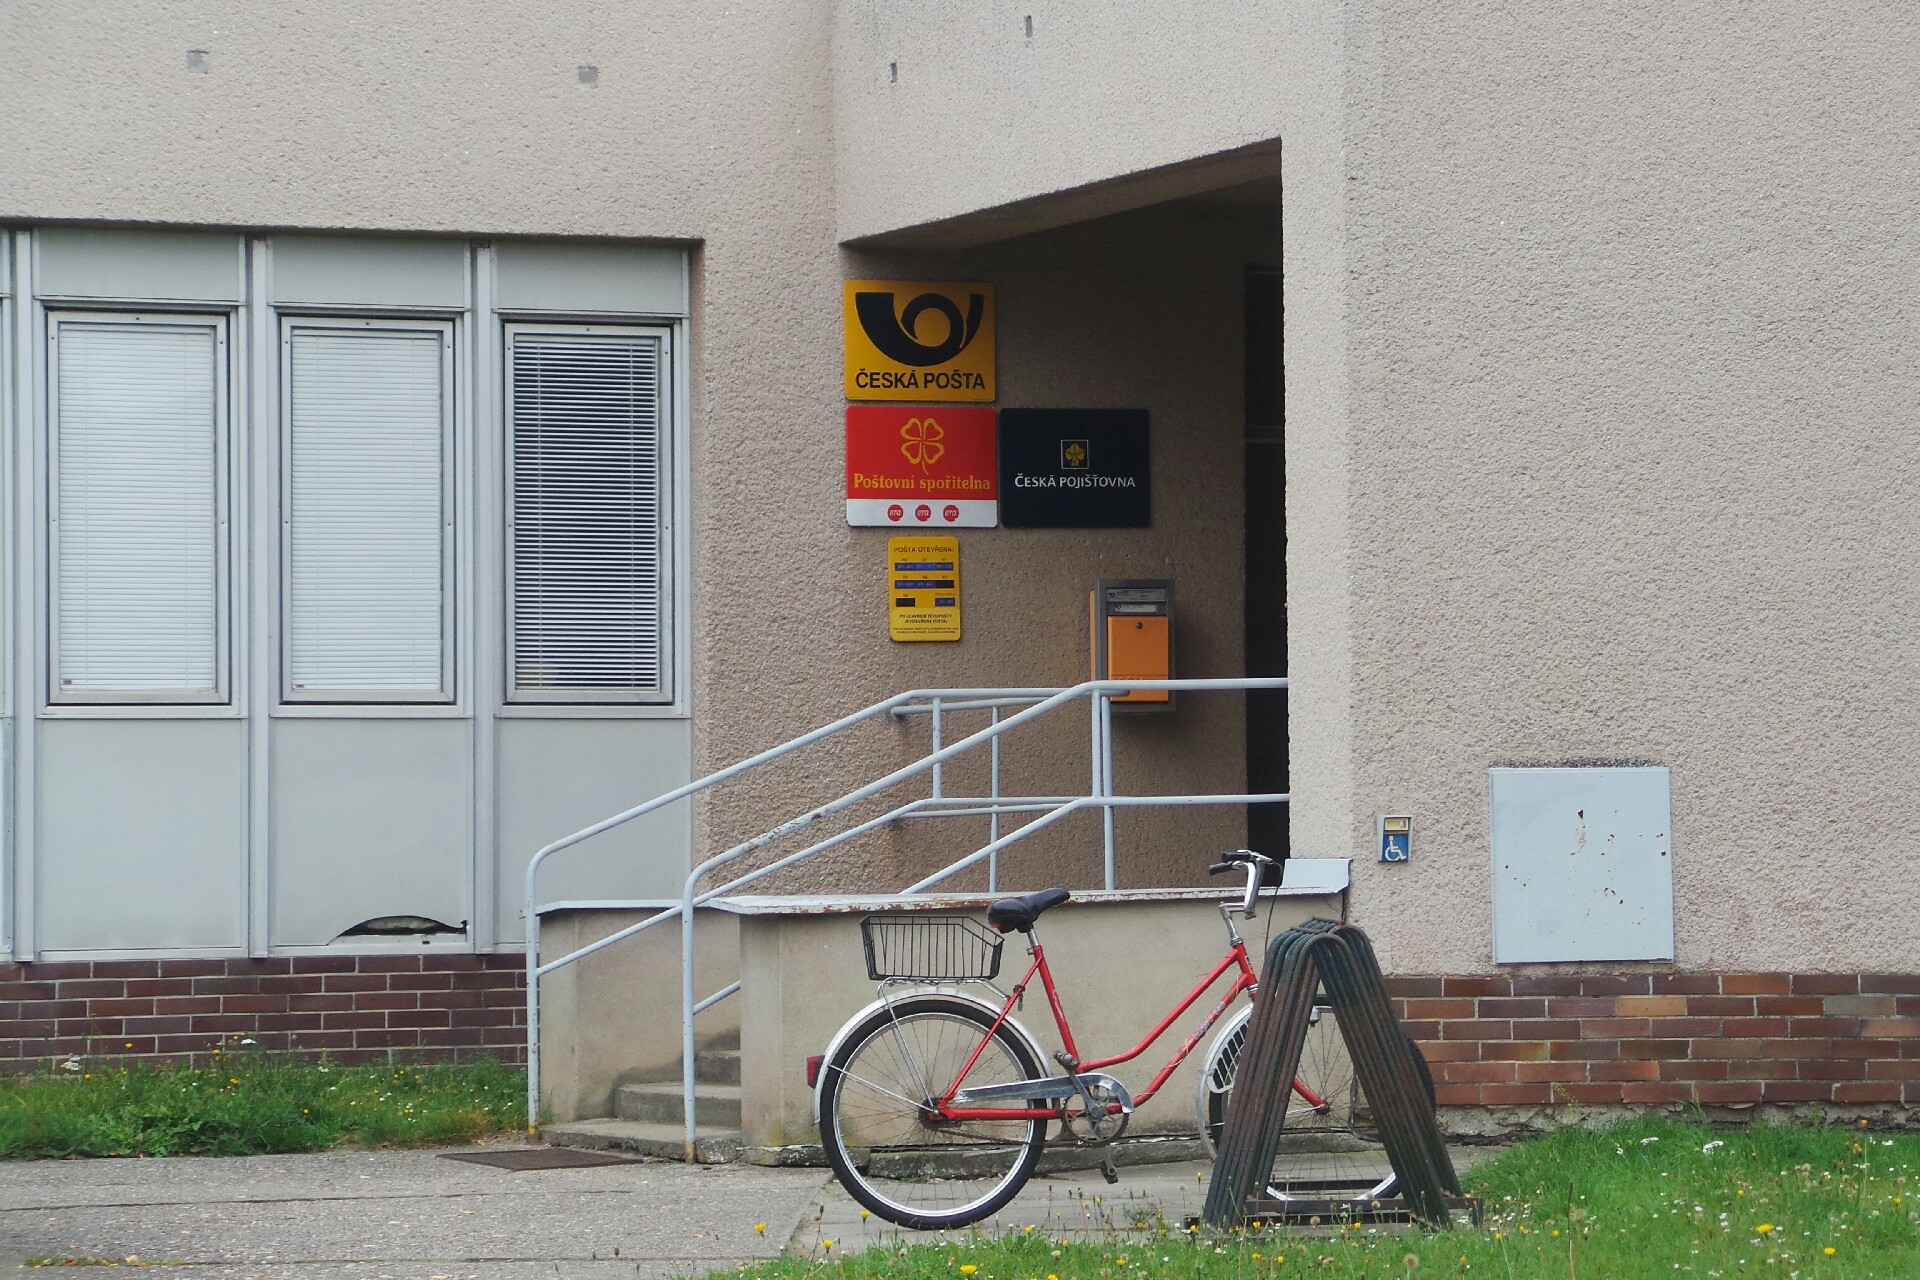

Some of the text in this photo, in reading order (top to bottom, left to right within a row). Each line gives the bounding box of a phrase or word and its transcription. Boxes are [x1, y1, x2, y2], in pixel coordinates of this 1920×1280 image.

[855, 368, 986, 390] ČESKÁ POŠTA
[853, 473, 991, 493] Poštovní spořitelna
[1014, 473, 1136, 489] ČESKÁ POJIŠŤOVNA
[916, 509, 930, 517] era
[944, 509, 958, 517] era
[893, 545, 916, 553] POŠTA
